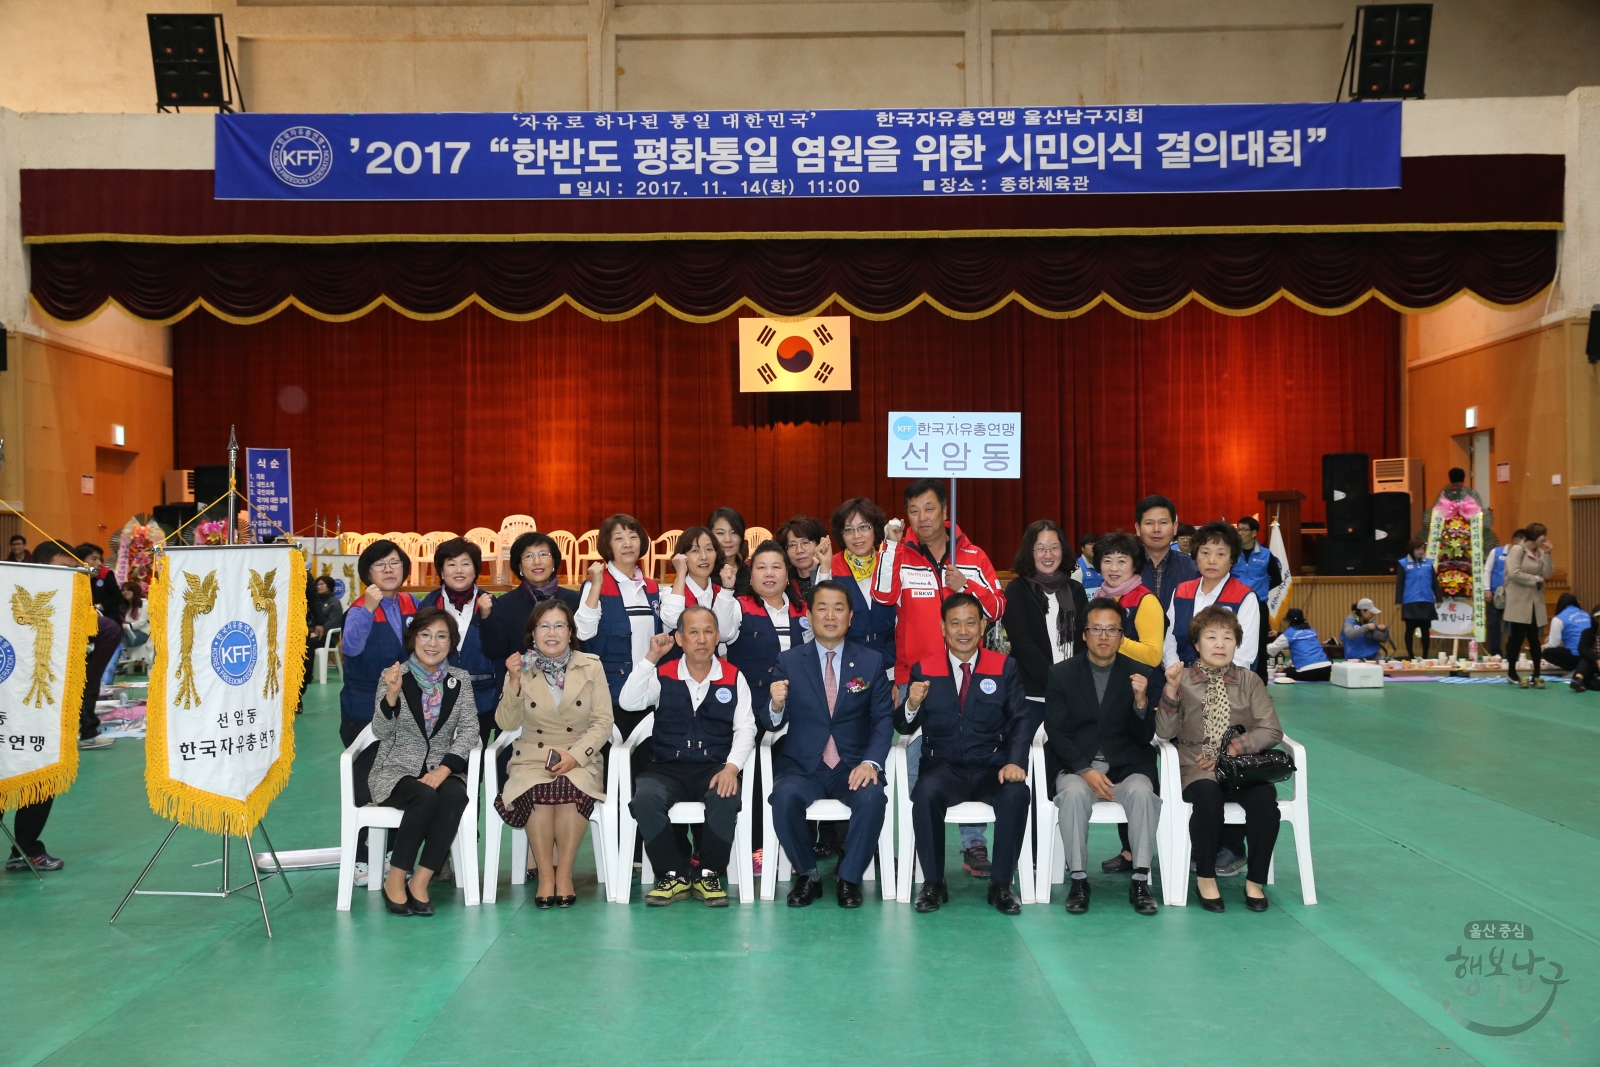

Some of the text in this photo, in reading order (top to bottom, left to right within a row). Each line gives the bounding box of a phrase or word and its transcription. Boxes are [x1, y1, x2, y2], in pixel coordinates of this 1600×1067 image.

[594, 113, 659, 131] 하나된
[668, 113, 711, 130] 통일
[875, 108, 1143, 128] 한국자유총연맹 울산남구지회
[283, 150, 320, 166] KFF
[633, 136, 778, 176] 평화통일
[791, 134, 901, 174] 염원을
[913, 134, 986, 173] 위한
[997, 131, 1142, 171] 시민의식
[636, 181, 688, 196] 2017.
[701, 181, 727, 195] 11.
[740, 178, 795, 196] 14(화)
[807, 179, 860, 194] 11:00
[1000, 175, 1090, 193] 종하체육관
[917, 422, 1015, 437] 한국자유총연맹
[221, 644, 251, 665] KFF
